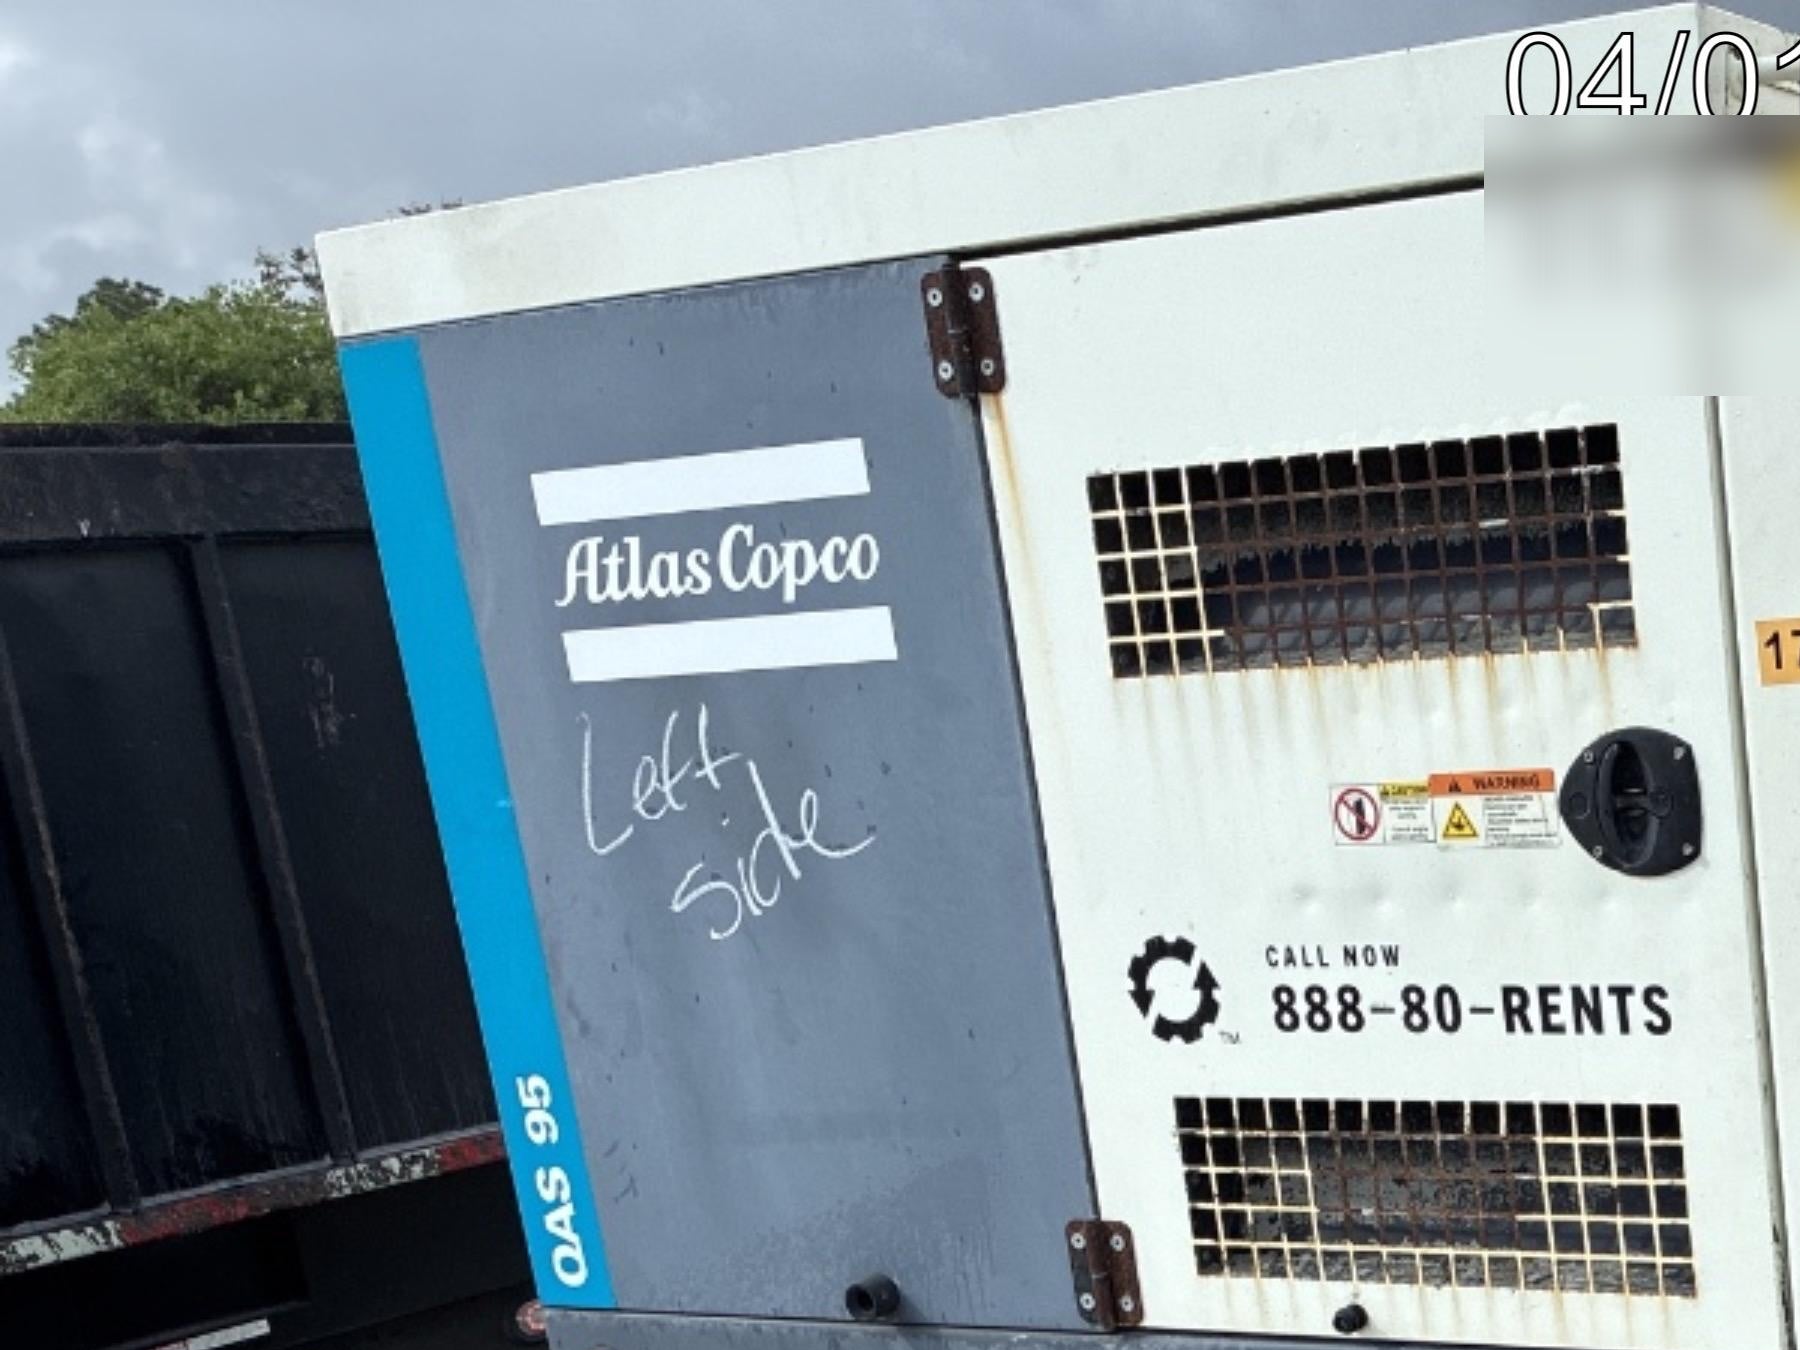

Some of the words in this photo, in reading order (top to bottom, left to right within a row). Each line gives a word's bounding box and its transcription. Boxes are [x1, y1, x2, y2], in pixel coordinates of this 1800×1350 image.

[576, 702, 744, 855] Left
[1472, 773, 1540, 791] WARNING
[1266, 944, 1331, 968] CALL
[1343, 943, 1400, 967] NOW
[1273, 983, 1672, 1036] 888-80-RENTS
[515, 1073, 560, 1146] 95
[535, 1165, 589, 1288] QAS
